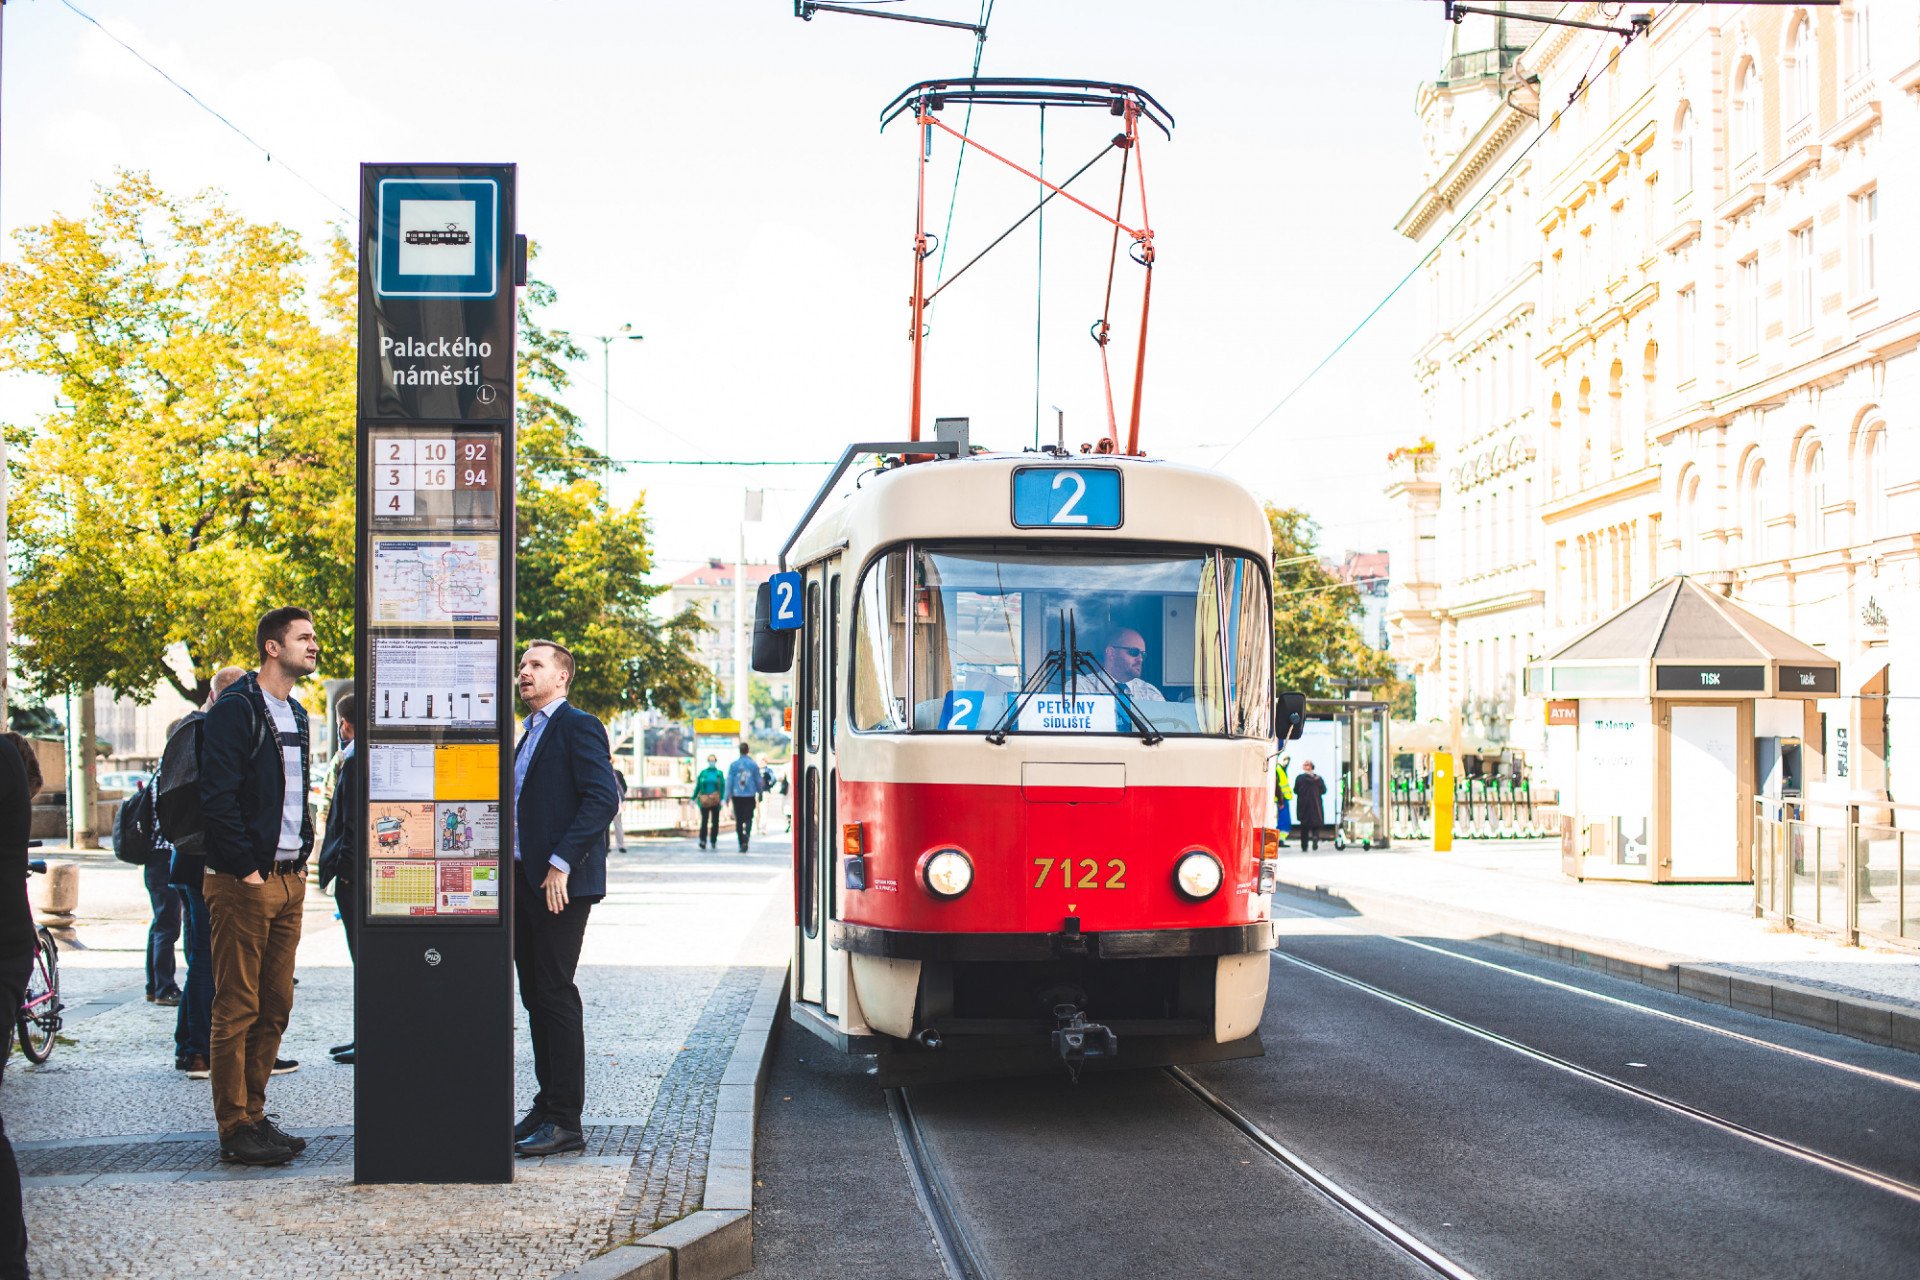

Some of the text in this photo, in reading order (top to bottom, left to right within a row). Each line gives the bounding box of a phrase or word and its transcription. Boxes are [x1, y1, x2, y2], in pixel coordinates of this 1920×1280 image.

[380, 337, 492, 358] Palackého
[393, 364, 479, 386] náměstí
[390, 444, 487, 461] 2 10 92
[389, 469, 487, 486] 3 16 94
[388, 494, 400, 512] 4
[1050, 471, 1088, 523] 2
[777, 582, 794, 620] 2
[1700, 672, 1720, 685] TISK
[951, 699, 976, 729] 2
[1037, 699, 1095, 714] PETŘINY
[1551, 708, 1576, 718] ATM
[1043, 716, 1091, 729] SÍDLIŠTĚ
[1034, 859, 1126, 888] 7122
